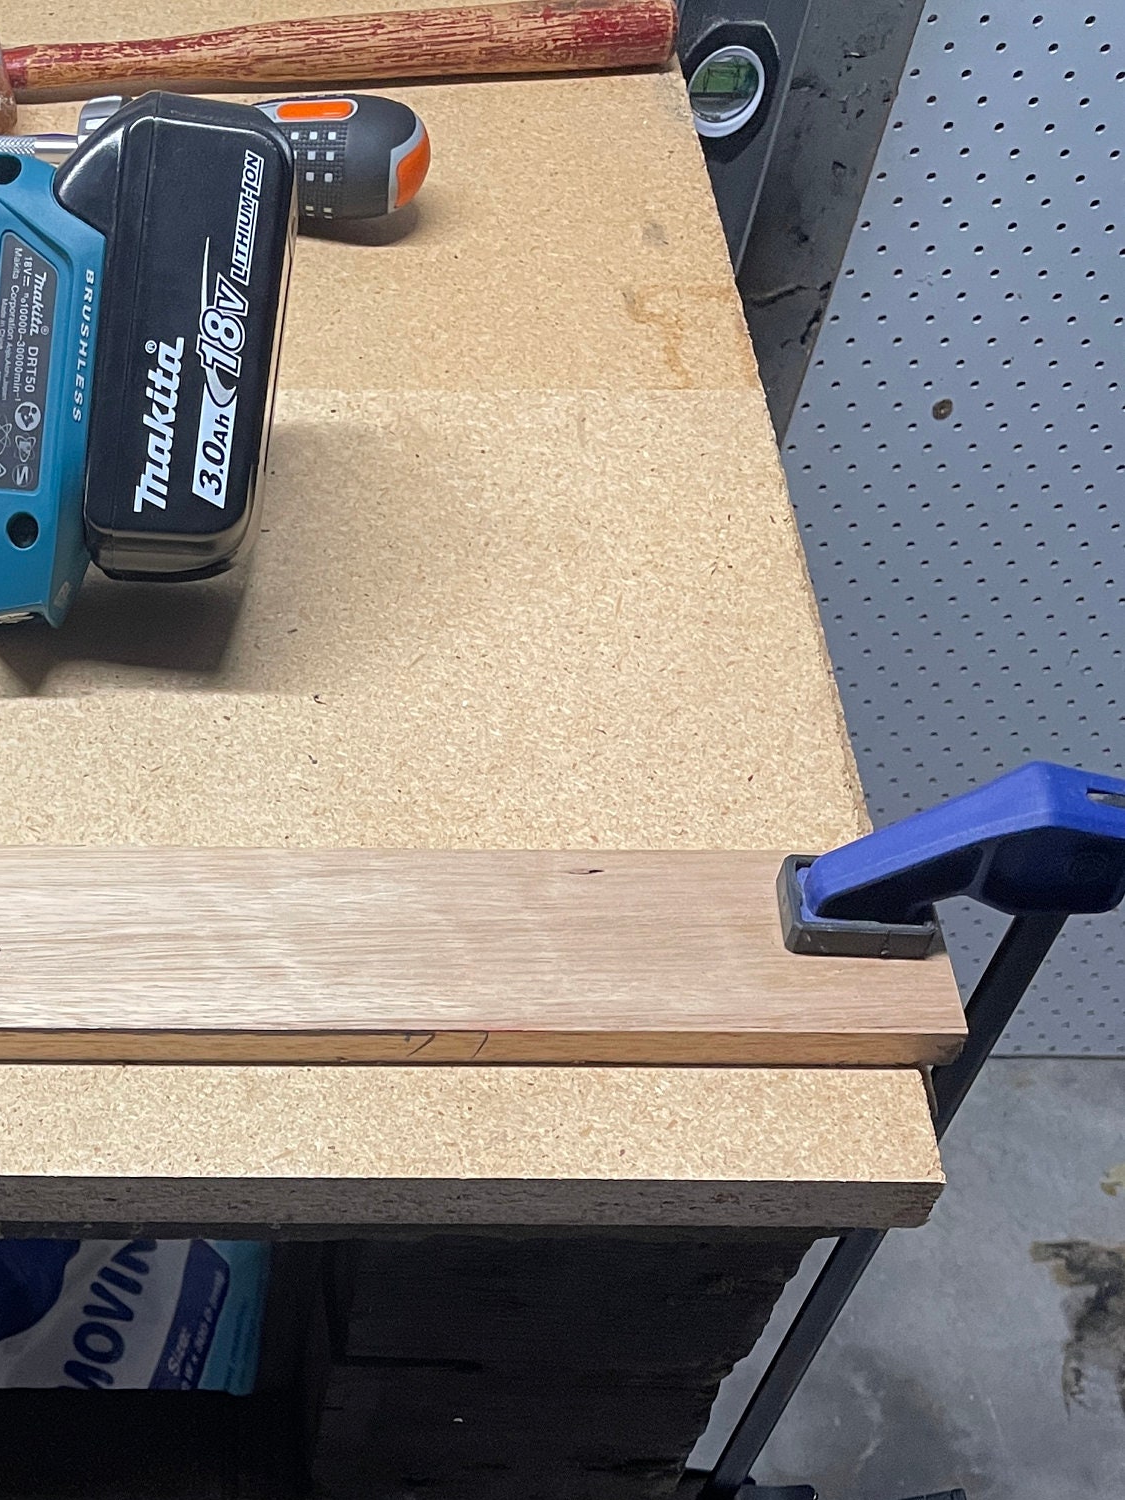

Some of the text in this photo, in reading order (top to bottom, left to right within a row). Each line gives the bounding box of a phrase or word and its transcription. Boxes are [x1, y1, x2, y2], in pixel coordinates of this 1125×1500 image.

[13, 248, 23, 279] Makita
[7, 285, 20, 340] Corporation
[196, 150, 265, 496] 3.0Ah 18V LITHIUM-ION
[24, 346, 39, 393] DRT50
[73, 268, 95, 423] BRUSHLESS
